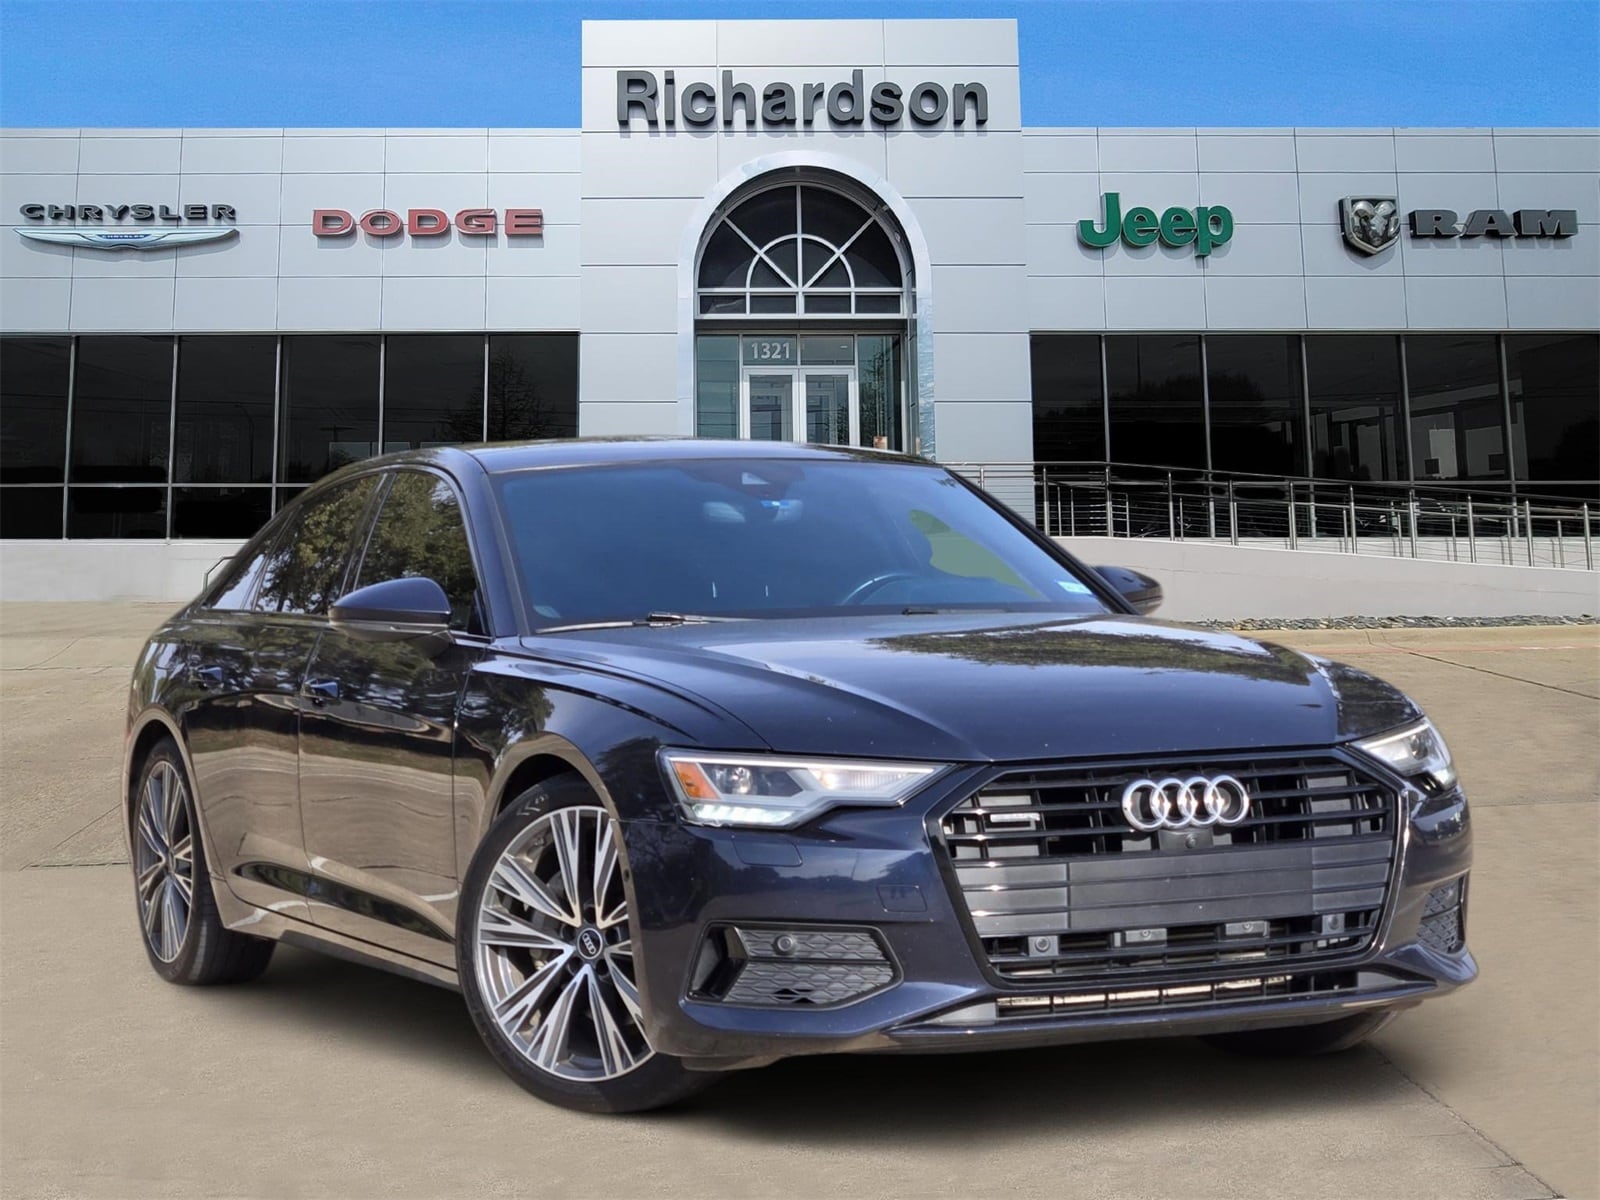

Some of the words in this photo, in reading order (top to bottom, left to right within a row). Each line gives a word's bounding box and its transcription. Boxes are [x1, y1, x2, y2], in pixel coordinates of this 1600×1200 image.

[616, 69, 989, 126] Richardson
[19, 203, 236, 221] CHRYSLER
[312, 209, 544, 236] DODGE
[1077, 192, 1235, 257] Jeep
[1410, 209, 1578, 238] RAM
[751, 342, 790, 359] 1321
